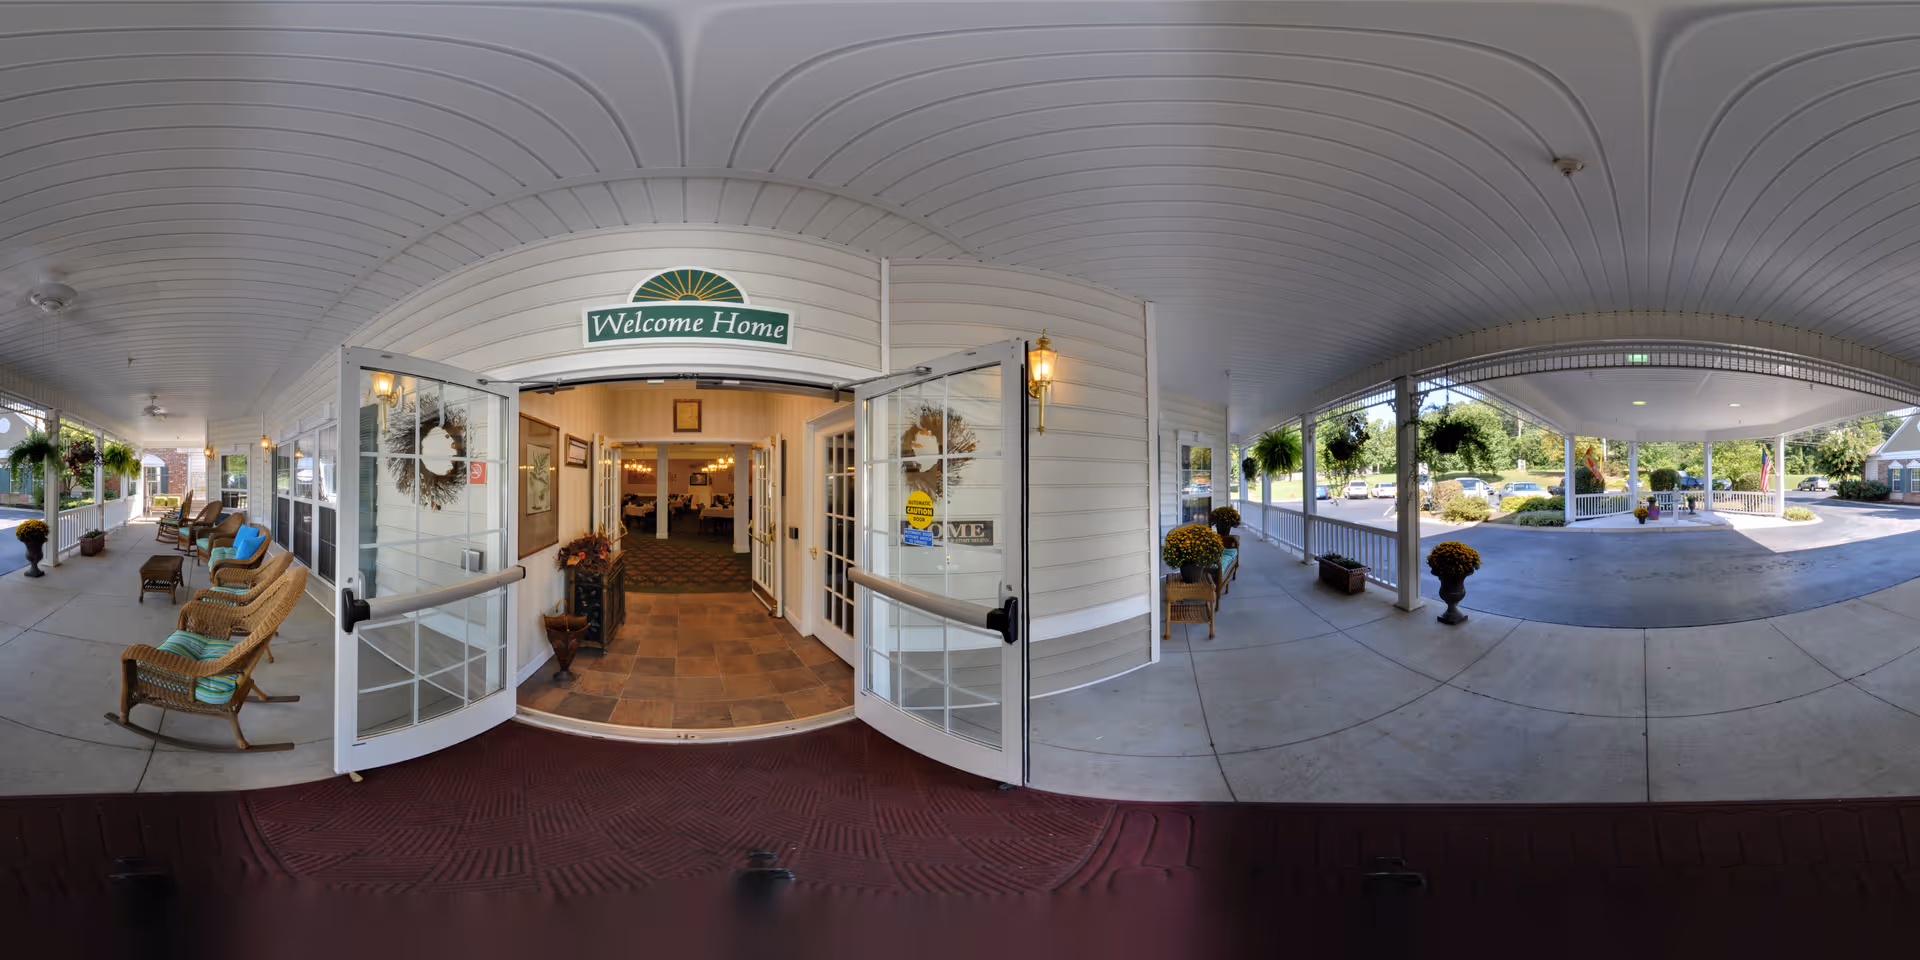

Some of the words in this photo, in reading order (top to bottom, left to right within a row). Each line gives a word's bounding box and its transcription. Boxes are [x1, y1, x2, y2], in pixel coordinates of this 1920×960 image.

[592, 310, 704, 337] Welcome
[710, 311, 785, 338] Home
[907, 506, 933, 516] CAUTION
[908, 523, 985, 539] OME
